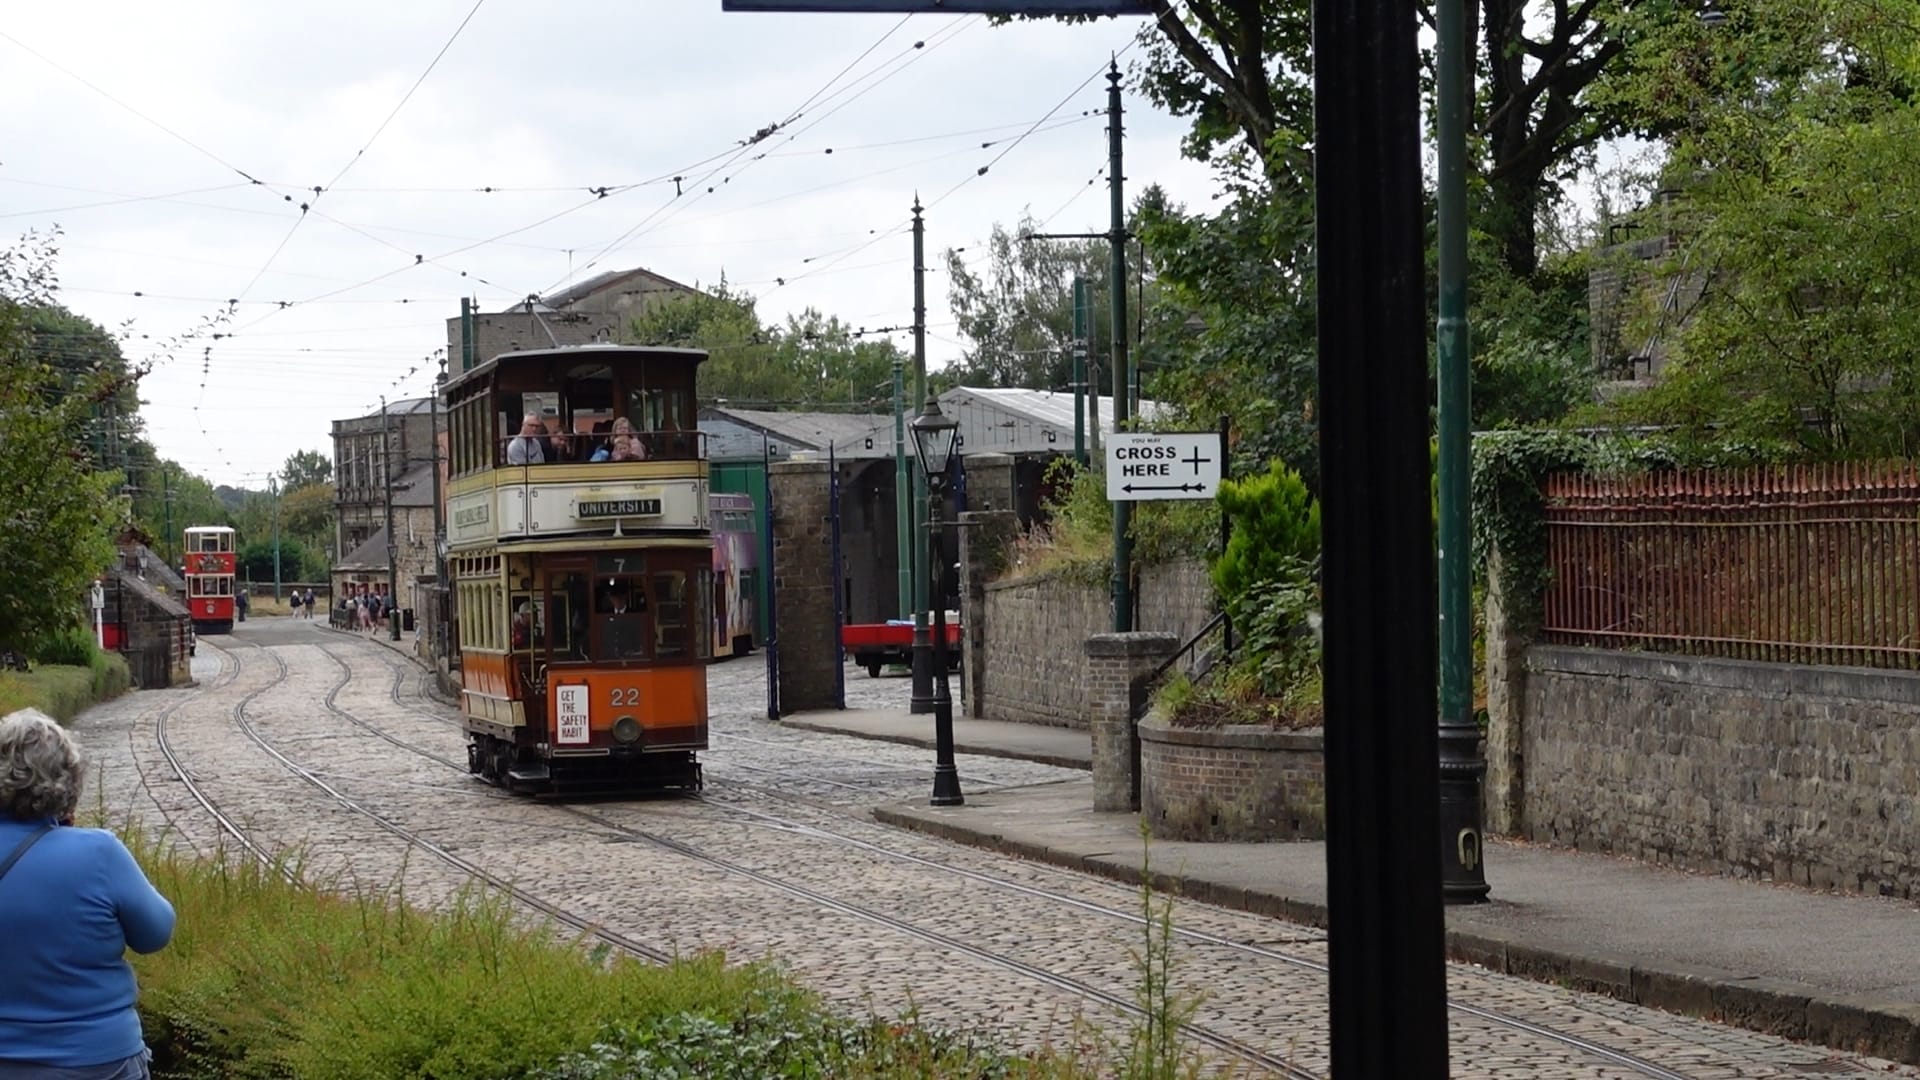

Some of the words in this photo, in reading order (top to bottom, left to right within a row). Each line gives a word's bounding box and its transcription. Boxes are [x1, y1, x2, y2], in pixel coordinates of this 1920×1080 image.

[1116, 447, 1176, 459] CROSS
[1123, 464, 1170, 476] HERE
[580, 500, 655, 514] UNIVERSITY
[614, 559, 624, 573] 7
[561, 691, 574, 701] GET
[611, 688, 639, 706] 22
[562, 703, 575, 713] THE
[561, 715, 586, 725] SAFETY
[562, 728, 582, 737] HABIT
